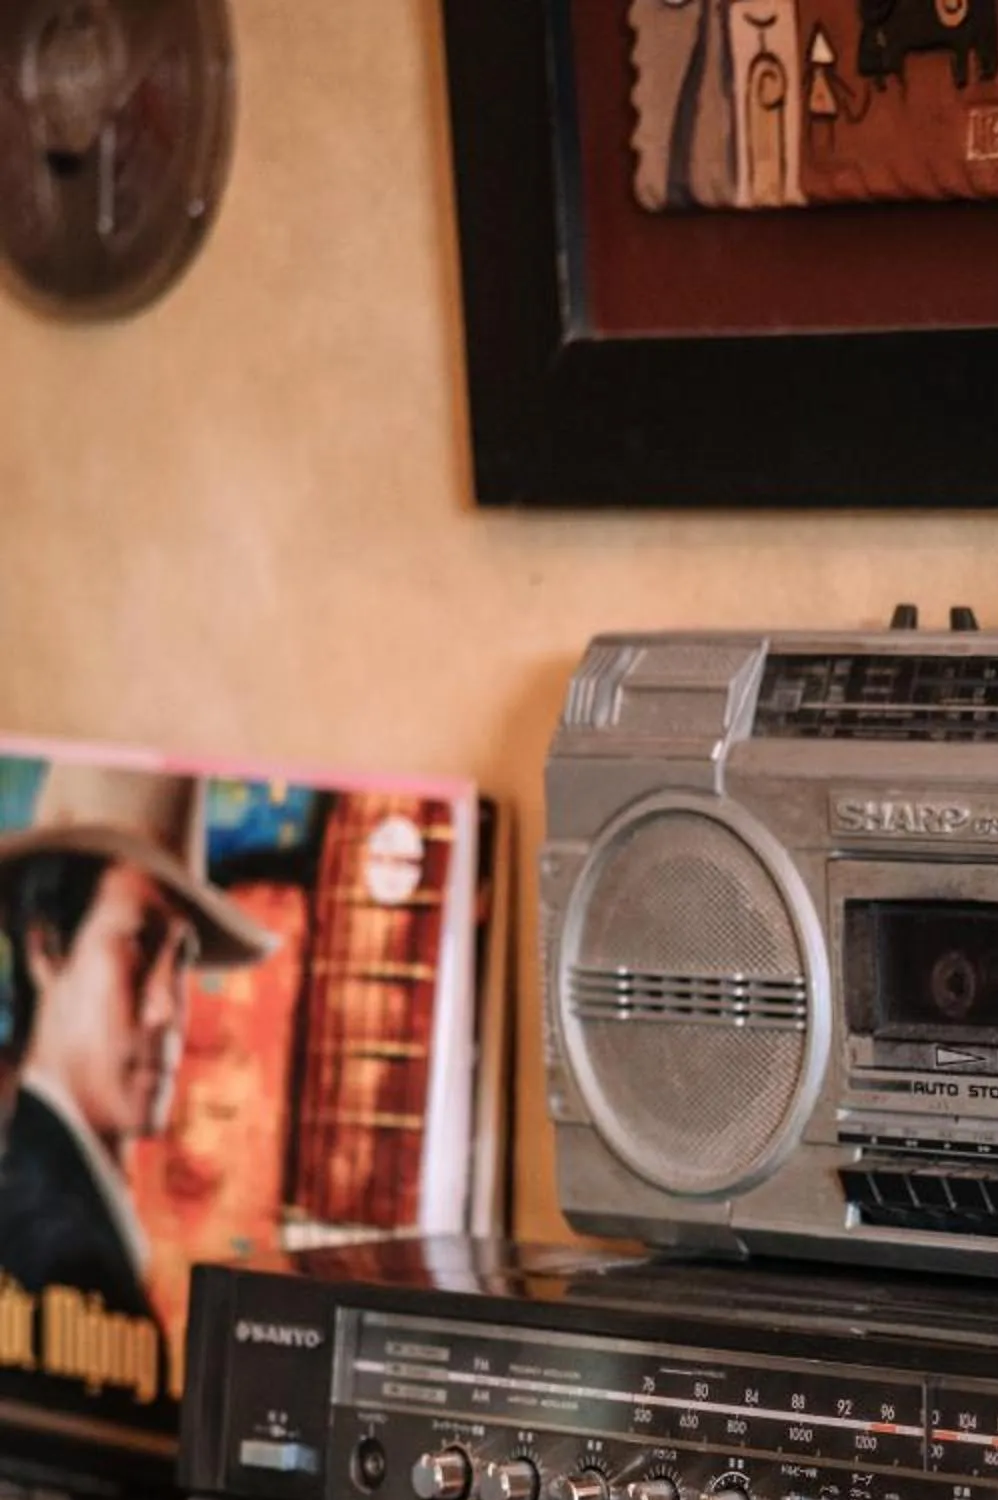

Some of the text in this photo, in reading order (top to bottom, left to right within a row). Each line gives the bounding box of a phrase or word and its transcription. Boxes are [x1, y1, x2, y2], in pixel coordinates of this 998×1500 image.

[836, 799, 971, 834] SHARP
[912, 1080, 959, 1098] AUTO
[251, 1322, 322, 1348] SANYO
[693, 1381, 709, 1399] 80
[744, 1388, 759, 1404] 84
[791, 1393, 806, 1410] 88
[836, 1399, 852, 1416] 92
[880, 1403, 896, 1421] 96
[958, 1413, 977, 1430] 104
[788, 1427, 813, 1443] 1000
[855, 1435, 878, 1450] 1200
